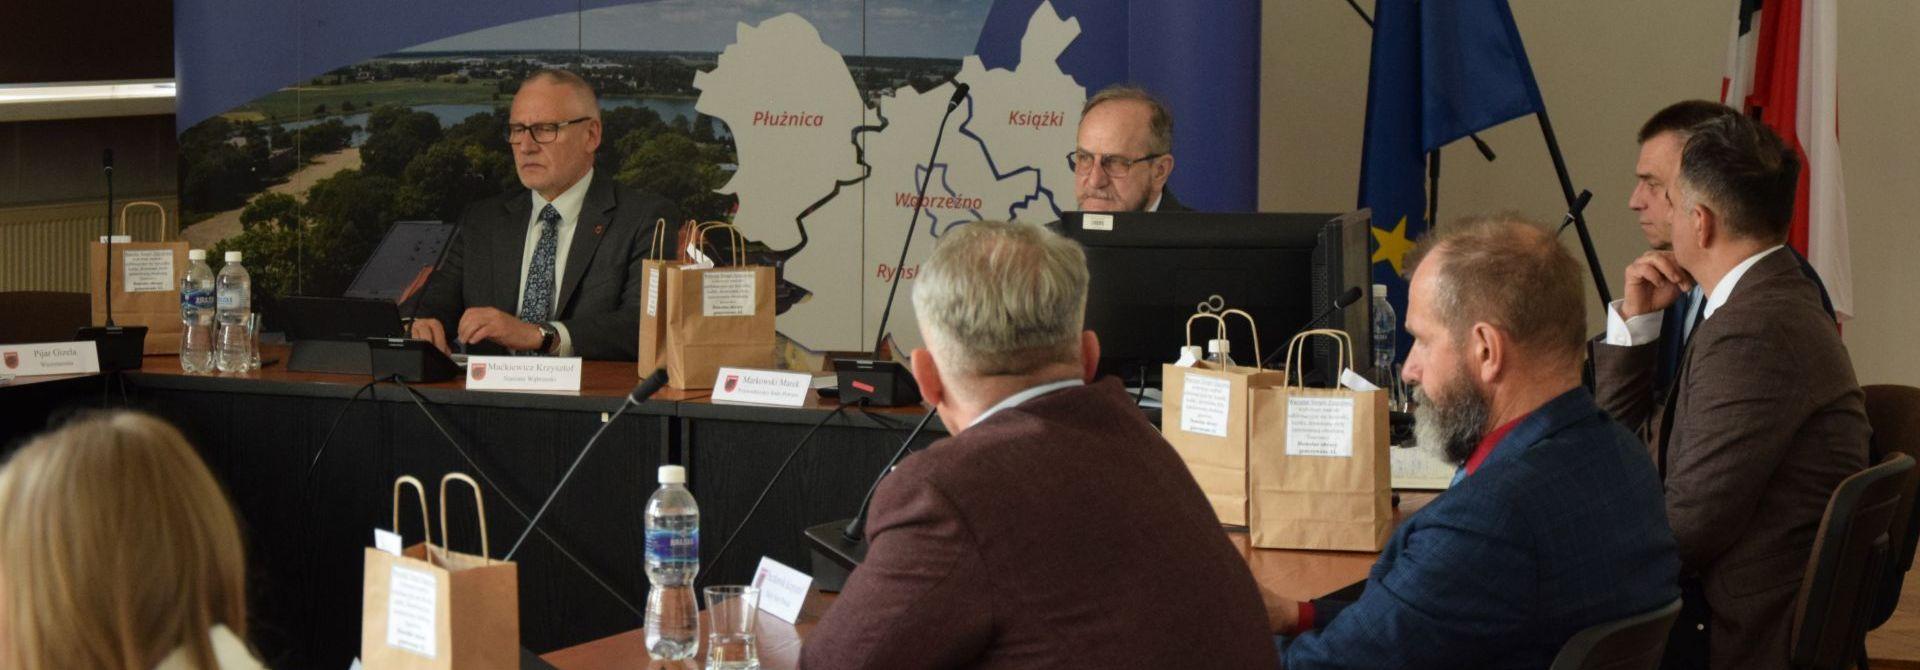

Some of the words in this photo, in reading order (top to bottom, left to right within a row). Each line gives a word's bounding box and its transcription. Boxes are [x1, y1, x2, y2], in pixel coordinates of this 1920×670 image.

[753, 111, 824, 127] Płużnica
[1008, 110, 1065, 130] Książki
[489, 362, 534, 373] Mackiewicz
